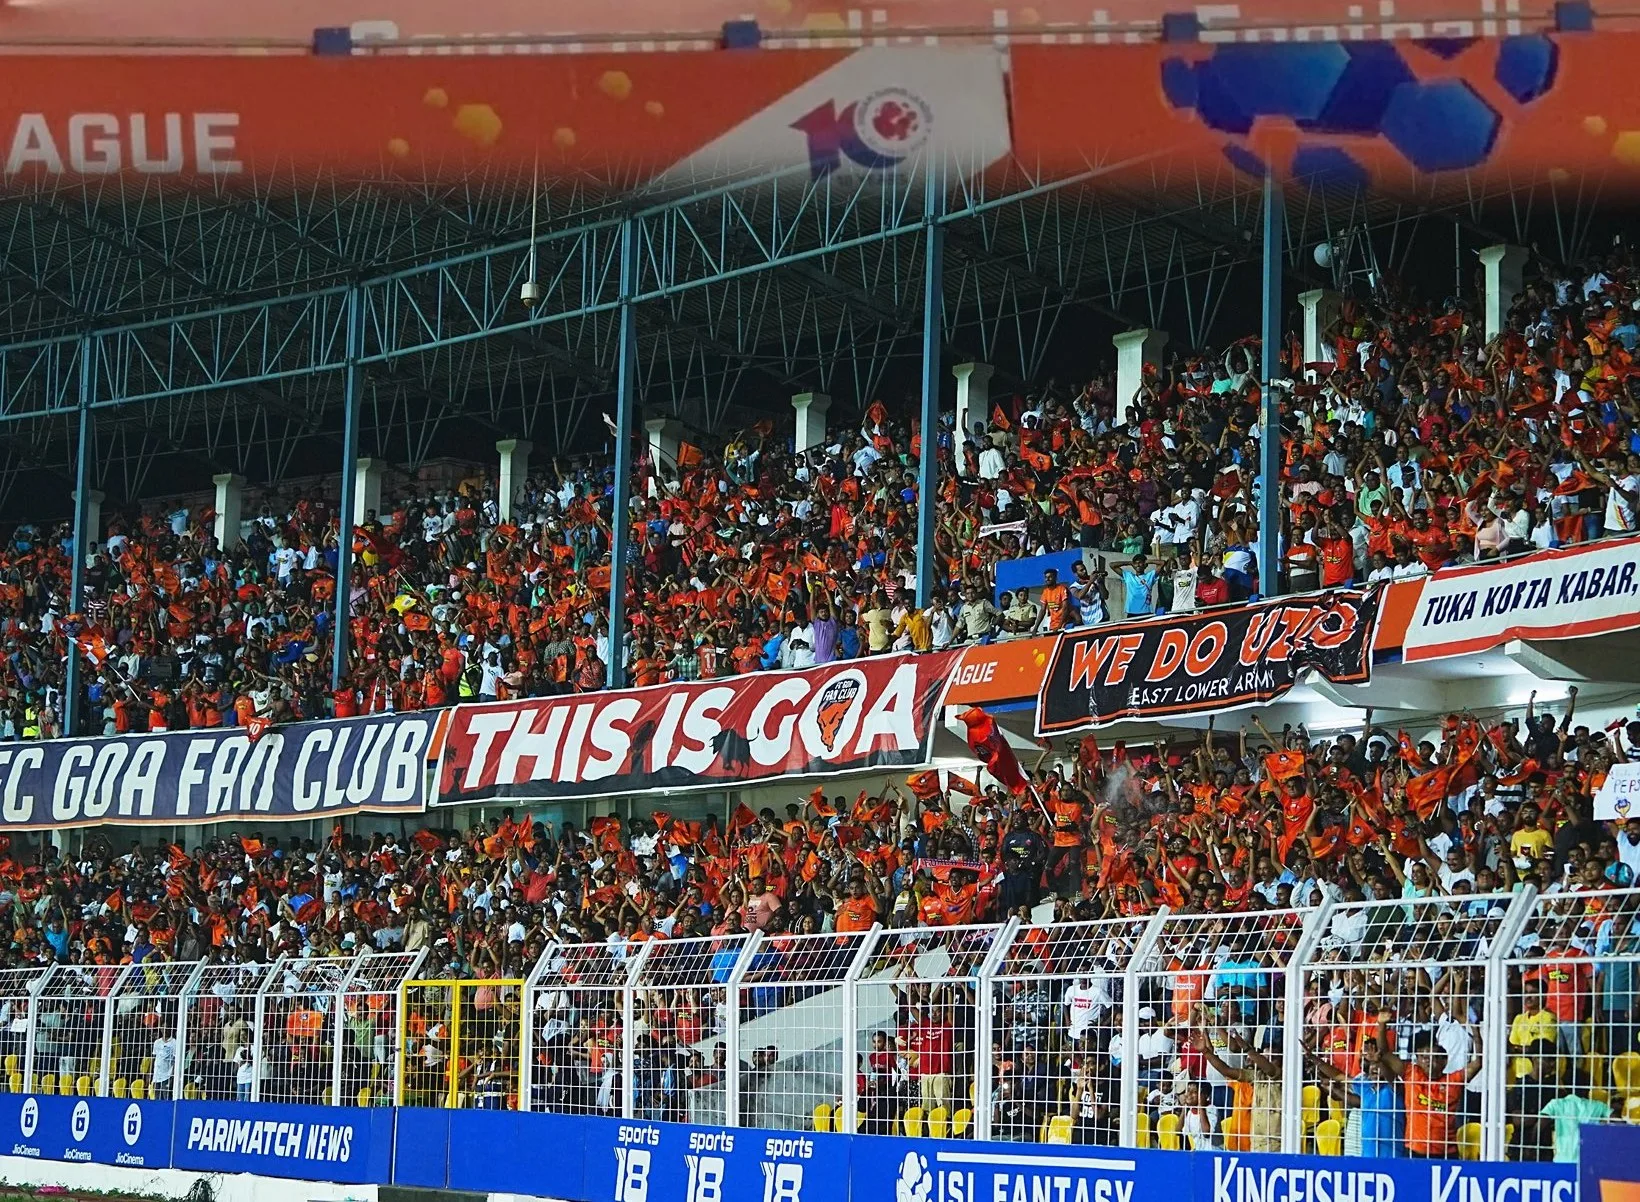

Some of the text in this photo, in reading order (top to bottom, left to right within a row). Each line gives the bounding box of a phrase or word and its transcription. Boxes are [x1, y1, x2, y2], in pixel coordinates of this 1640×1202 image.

[6, 113, 244, 174] AGUE
[1422, 590, 1478, 627] TUKA
[1555, 561, 1638, 605] KABAR,
[1067, 633, 1144, 692] WE
[1145, 620, 1229, 683] DO
[837, 687, 858, 701] CLUB
[1131, 670, 1276, 706] EAST LOWER ARMY
[463, 663, 919, 789] THIS IS GOA
[52, 741, 167, 821] GOA
[175, 733, 286, 816] FAN
[292, 719, 428, 811] CLUB
[12, 1144, 40, 1156] JioCinema
[63, 1148, 91, 1160] JioCinema
[188, 1117, 353, 1162] PARIMATCH NEWS
[618, 1125, 660, 1146] sports
[689, 1131, 734, 1153] sports
[765, 1136, 814, 1160] sports
[115, 1152, 144, 1165] JioCinema
[613, 1147, 651, 1202] 18
[684, 1154, 725, 1202] 18
[760, 1161, 804, 1202] 18
